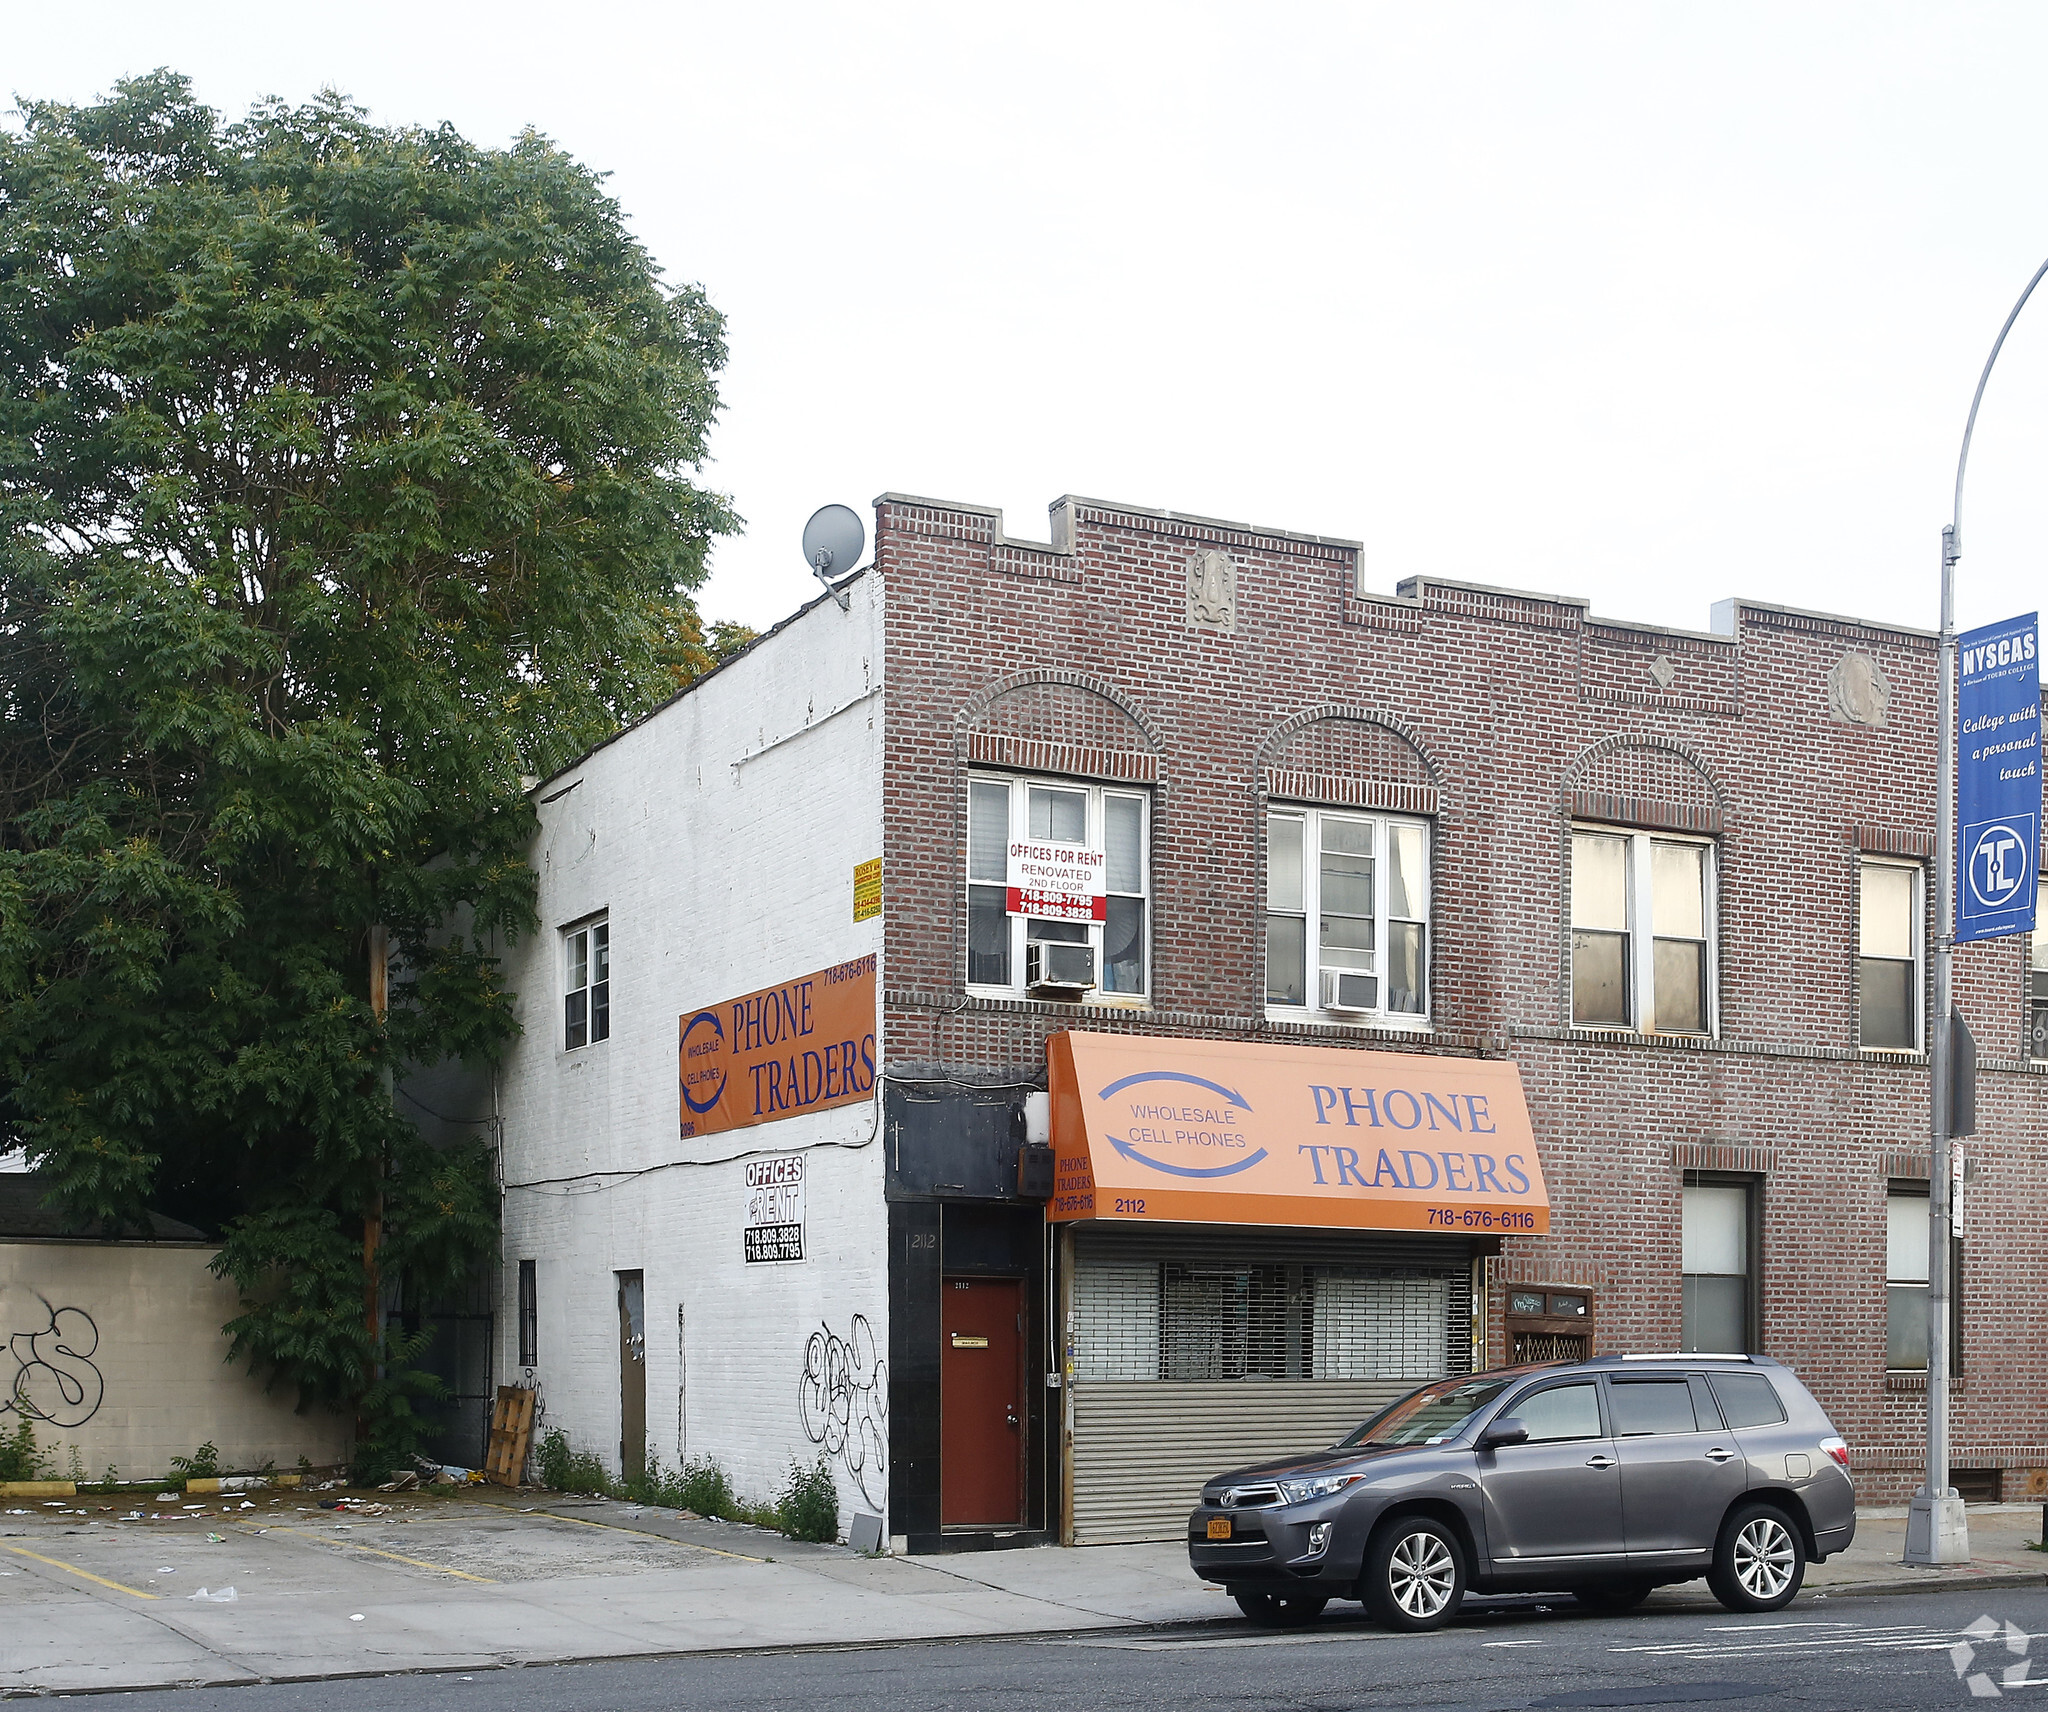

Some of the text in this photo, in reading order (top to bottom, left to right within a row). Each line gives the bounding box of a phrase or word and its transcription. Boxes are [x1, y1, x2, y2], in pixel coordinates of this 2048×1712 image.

[1962, 632, 2036, 676] NYSCAS
[1987, 670, 2007, 680] TOURO
[2008, 663, 2034, 674] COLLEGE
[1962, 703, 2037, 734] College with
[1972, 731, 2037, 762] a personal
[1999, 760, 2036, 781] touch
[1010, 844, 1104, 867] OFFICES FOR RENT
[1021, 863, 1092, 881] RENOVATED
[1028, 877, 1084, 892] 2ND FLOOR
[1019, 888, 1093, 907] 718-809-7795
[1019, 901, 1093, 919] 718-809-3828
[823, 954, 876, 986] 718-676-6116
[732, 980, 814, 1055] PHONE
[687, 1038, 720, 1059] WHOLESALE
[687, 1067, 720, 1085] CELL PHONES
[748, 1033, 875, 1116] TRADERS
[1129, 1104, 1237, 1126] WHOLESALE
[1307, 1084, 1497, 1135] PHONE
[1128, 1126, 1247, 1149] CELL PHONES
[746, 1157, 802, 1187] OFFICES
[1059, 1156, 1088, 1173] PHONE
[1298, 1143, 1532, 1196] TRADERS
[1057, 1175, 1092, 1192] TRADERS
[755, 1184, 798, 1225] RENT
[1114, 1197, 1146, 1215] 2112
[1426, 1207, 1535, 1229] 718-676-6116
[745, 1226, 800, 1246] 718.809.3828
[911, 1233, 936, 1249] 2112
[745, 1242, 800, 1261] 718.809.7795
[954, 1282, 970, 1290] 2112
